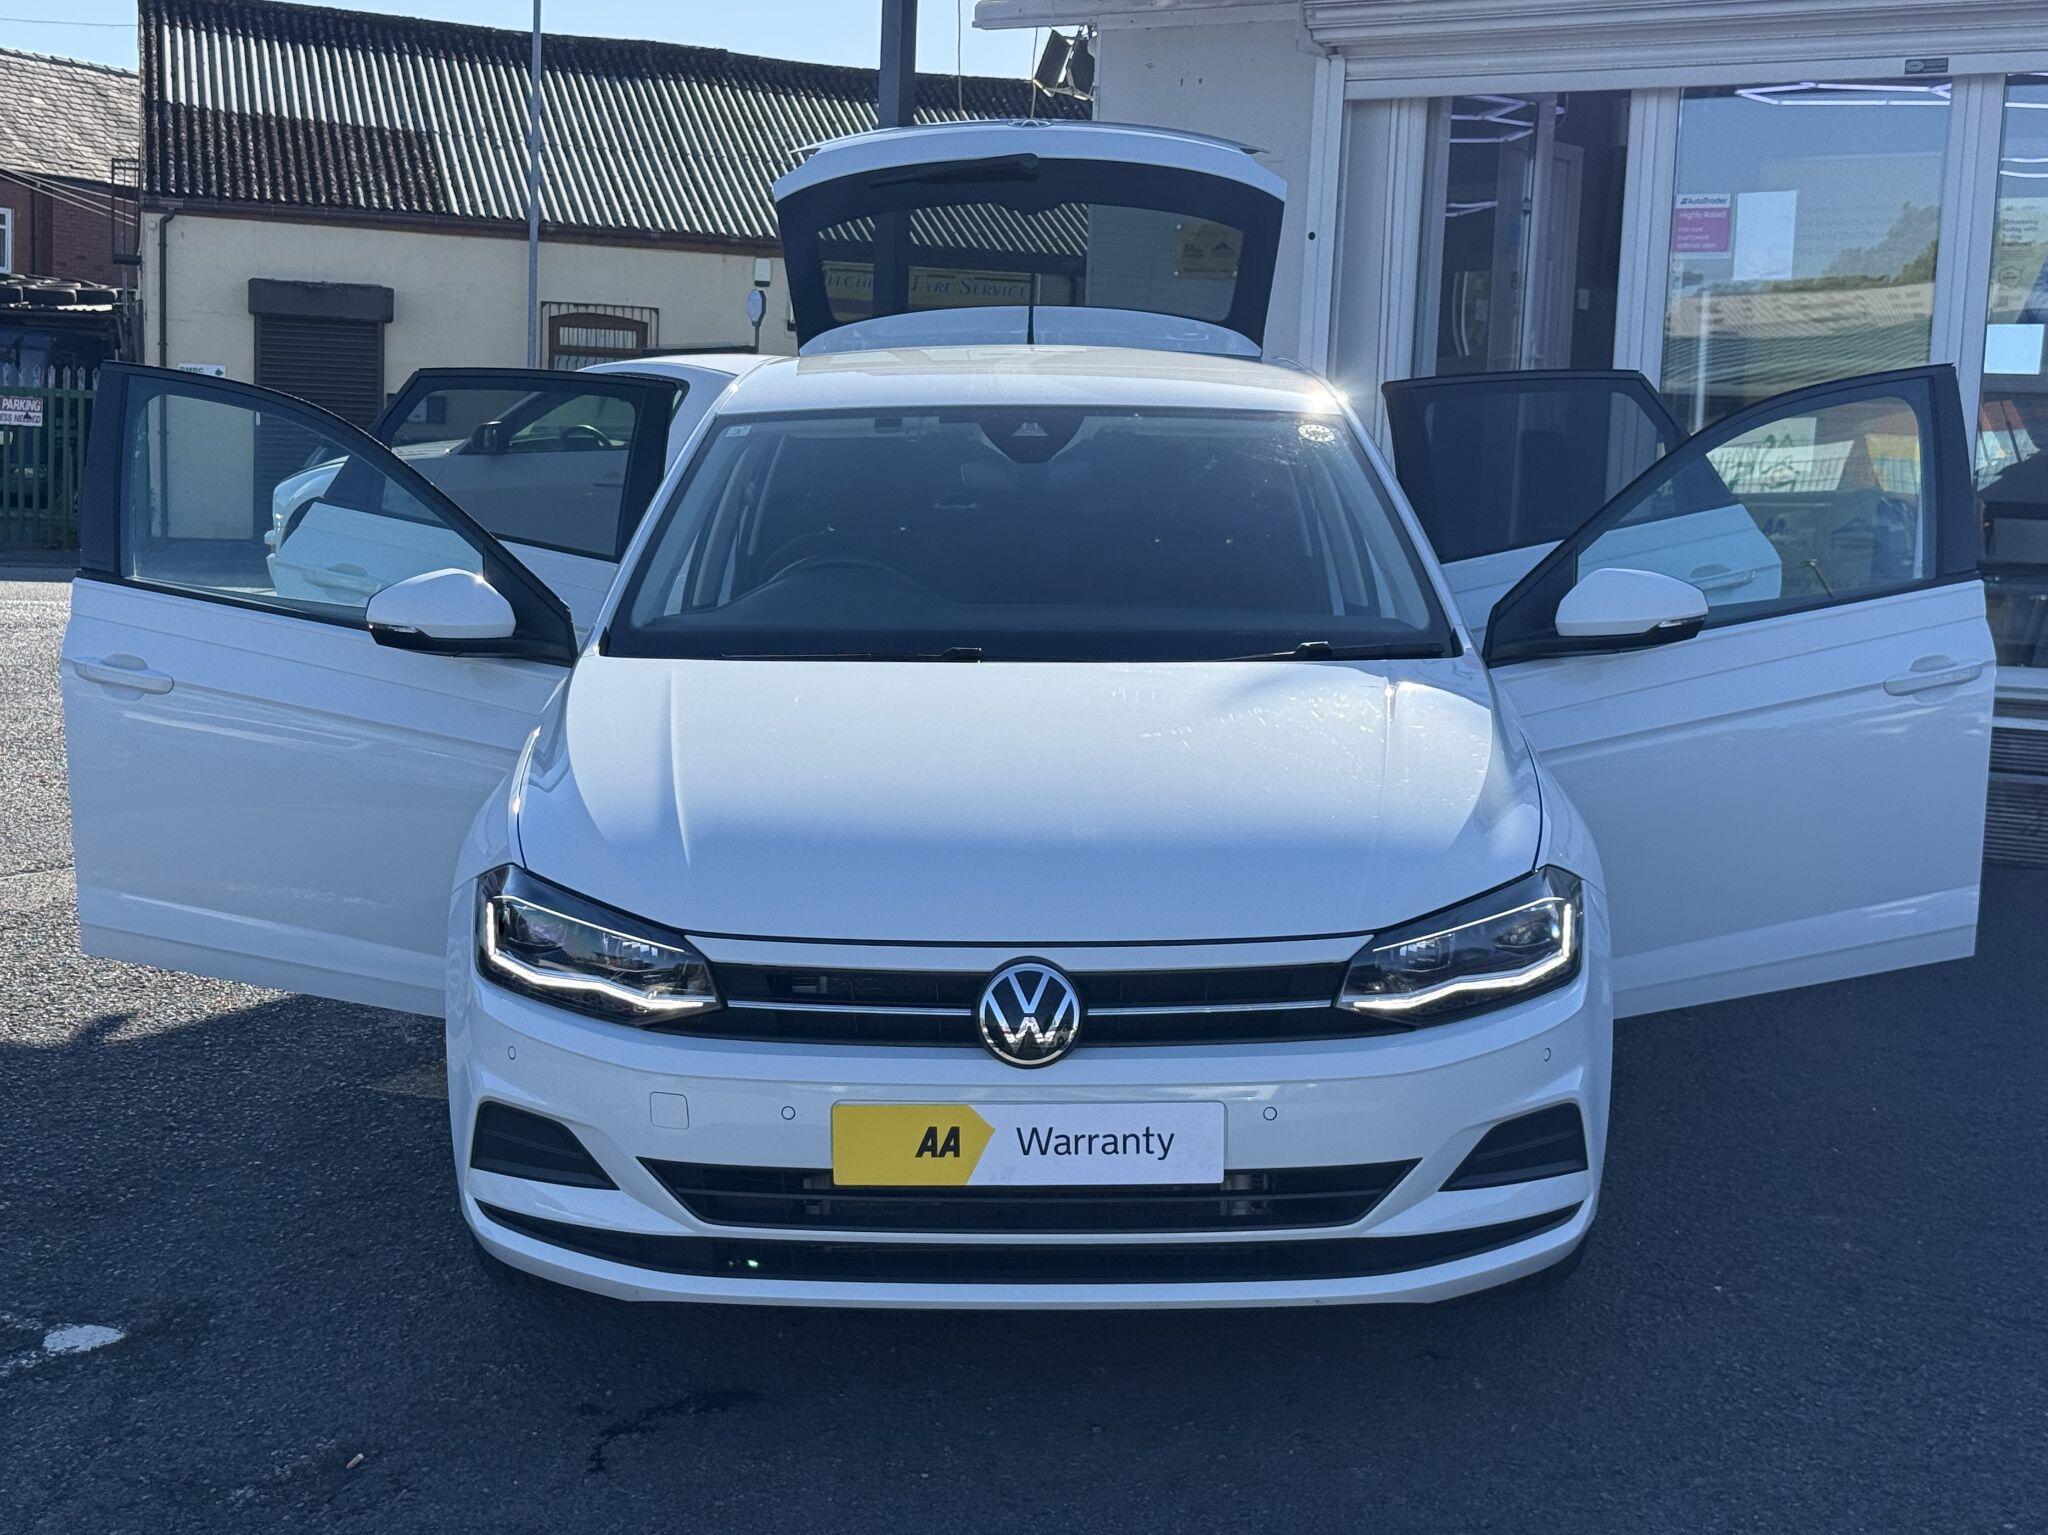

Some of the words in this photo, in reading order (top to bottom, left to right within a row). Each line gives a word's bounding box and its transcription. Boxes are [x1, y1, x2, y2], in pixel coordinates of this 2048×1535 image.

[2, 398, 41, 411] PARKING
[915, 1126, 961, 1158] AA
[1016, 1126, 1175, 1161] Warranty
